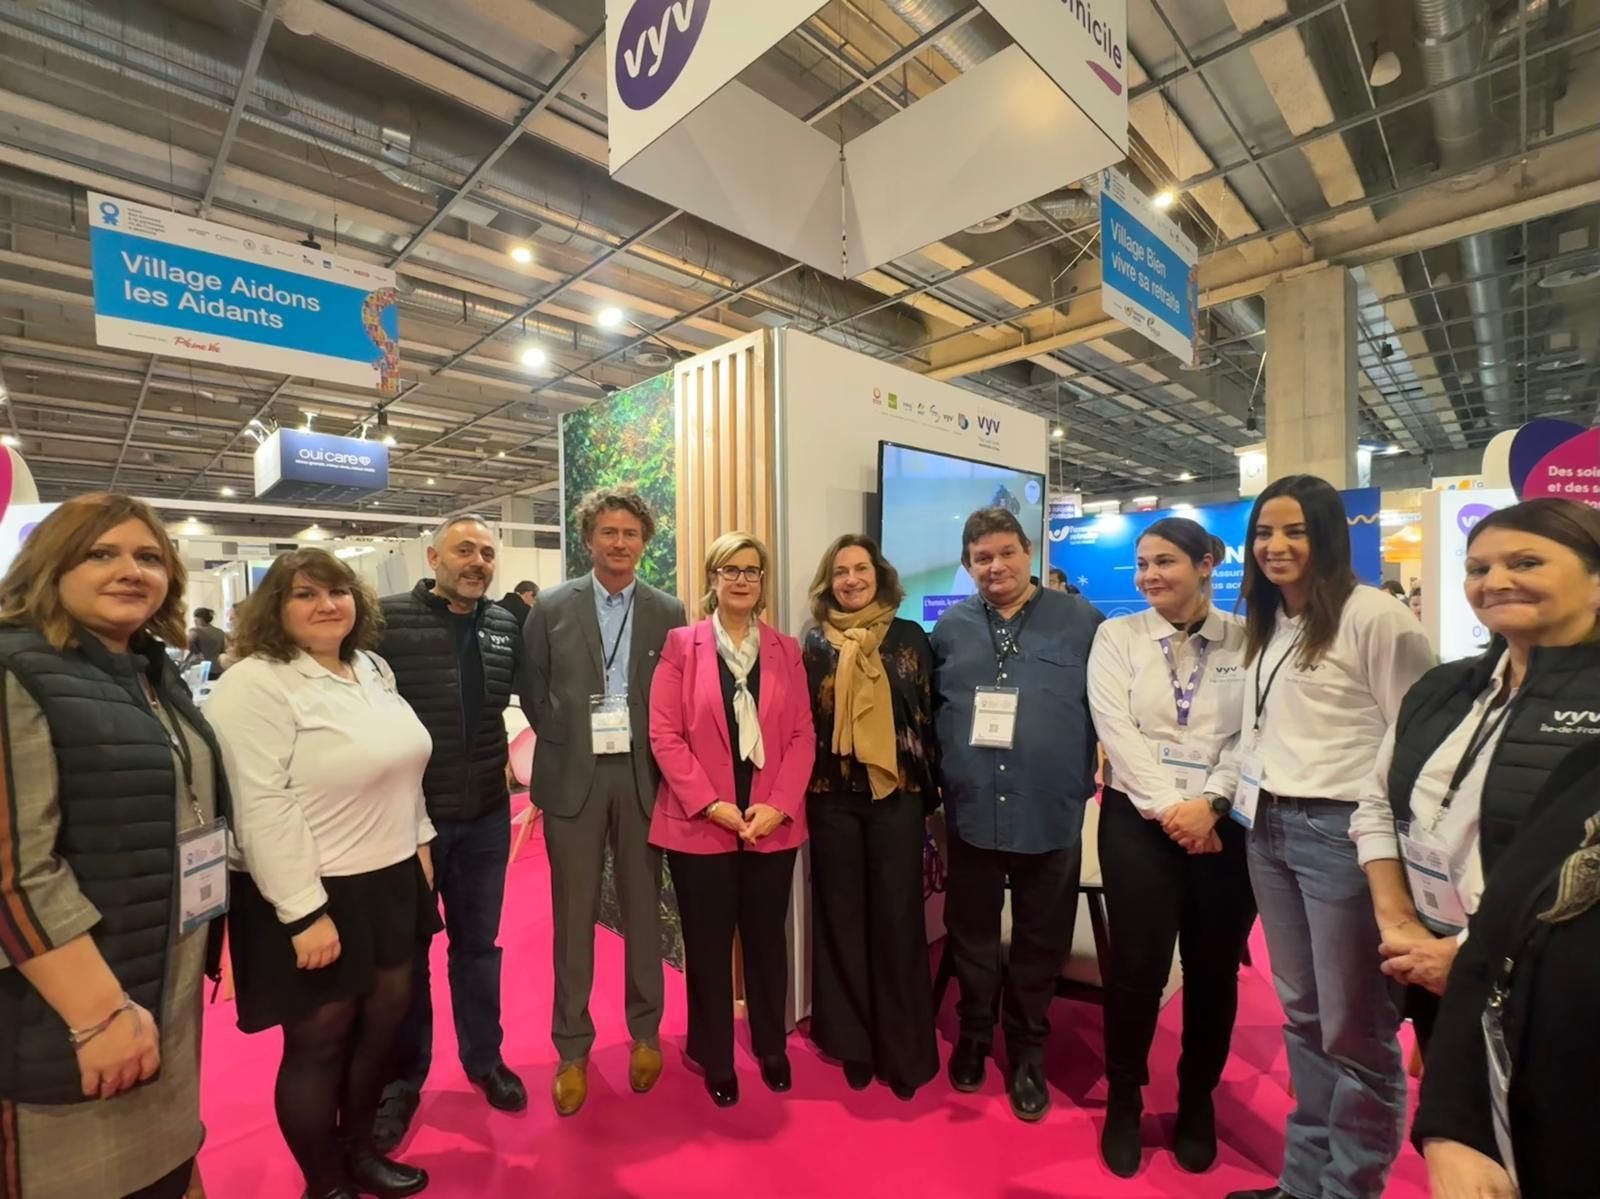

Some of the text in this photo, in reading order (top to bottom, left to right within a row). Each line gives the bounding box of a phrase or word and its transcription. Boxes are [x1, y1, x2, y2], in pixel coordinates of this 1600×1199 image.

[623, 0, 695, 78] vyv
[1062, 0, 1122, 70] micile
[1110, 217, 1167, 280] Village Bien
[120, 250, 321, 312] Village Aidons
[1138, 270, 1150, 292] sa
[1151, 280, 1180, 315] retraite
[124, 279, 284, 329] les Aidants
[978, 415, 1001, 436] vyv
[325, 451, 358, 465] care
[1548, 465, 1574, 477] Des
[1547, 482, 1562, 493] et
[1564, 481, 1590, 493] des
[1216, 665, 1238, 675] vyv
[1553, 710, 1600, 726] vyv
